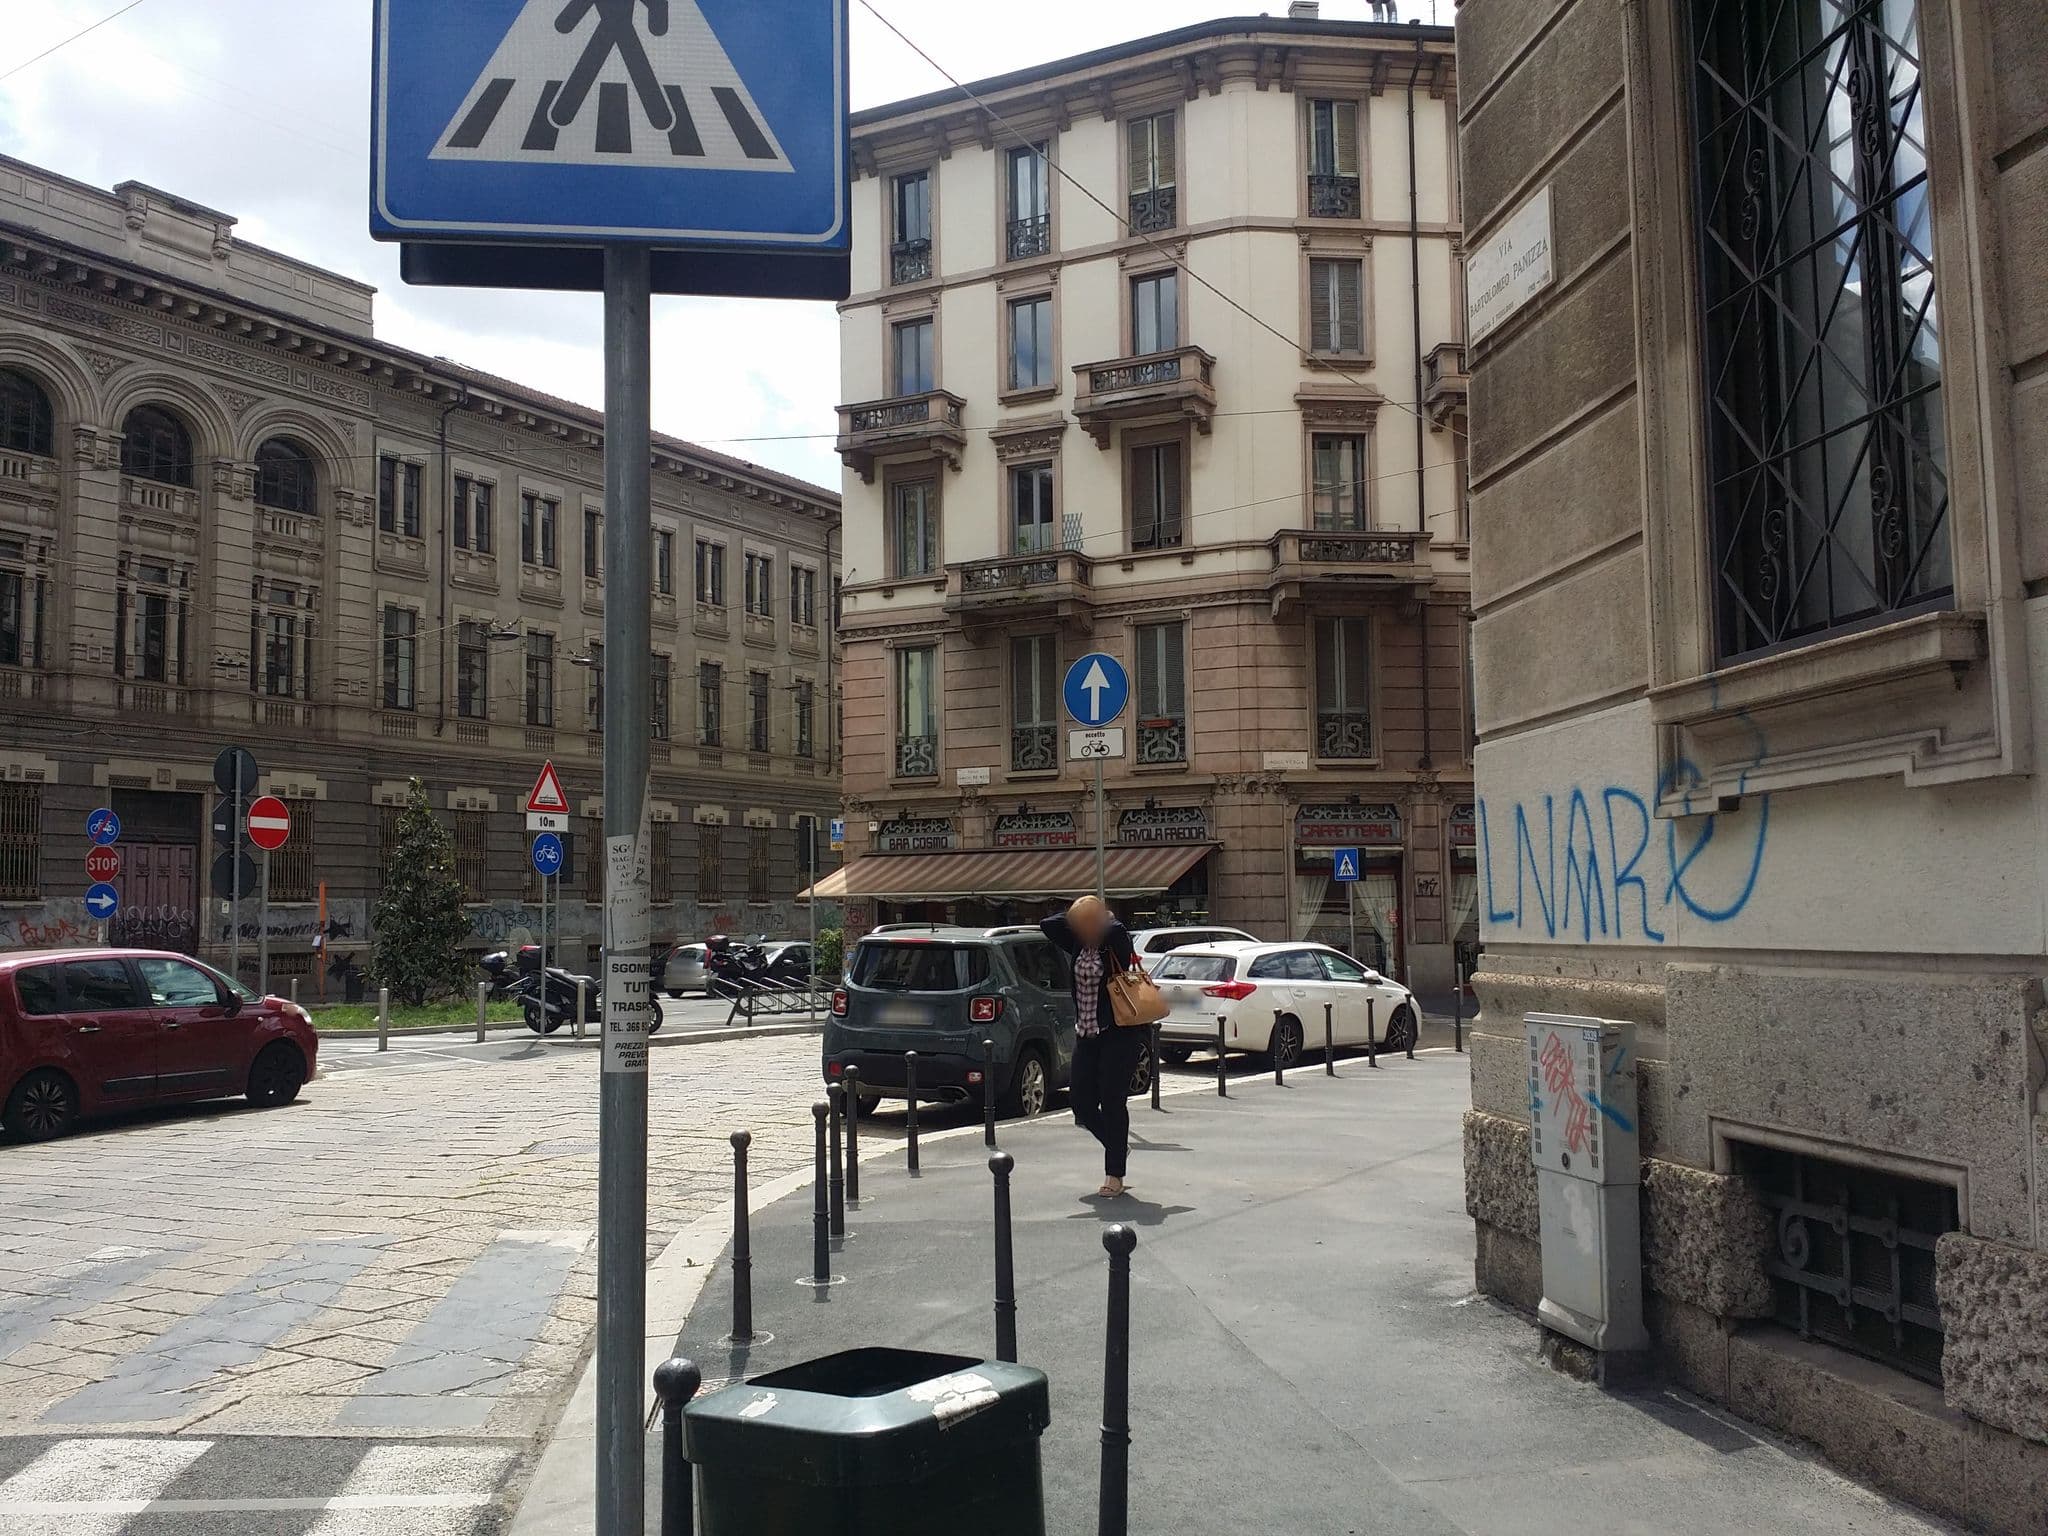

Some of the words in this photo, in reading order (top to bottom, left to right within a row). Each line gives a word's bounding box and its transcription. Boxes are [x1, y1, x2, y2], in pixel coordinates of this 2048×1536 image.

[1498, 237, 1513, 259] VIA
[1469, 272, 1510, 318] BARTOLOMEO
[1512, 236, 1549, 281] PANIZZA
[1085, 731, 1106, 739] eccetto
[1122, 828, 1163, 842] TAVOLA
[1164, 826, 1206, 841] FREDDA
[1301, 823, 1393, 838] CAFFETTERIA
[889, 837, 910, 850] BAR
[912, 836, 948, 849] COSMO
[88, 857, 118, 871] STOP
[610, 1022, 624, 1032] TEL.
[626, 1022, 640, 1032] 366
[614, 1042, 644, 1050] PREZZI
